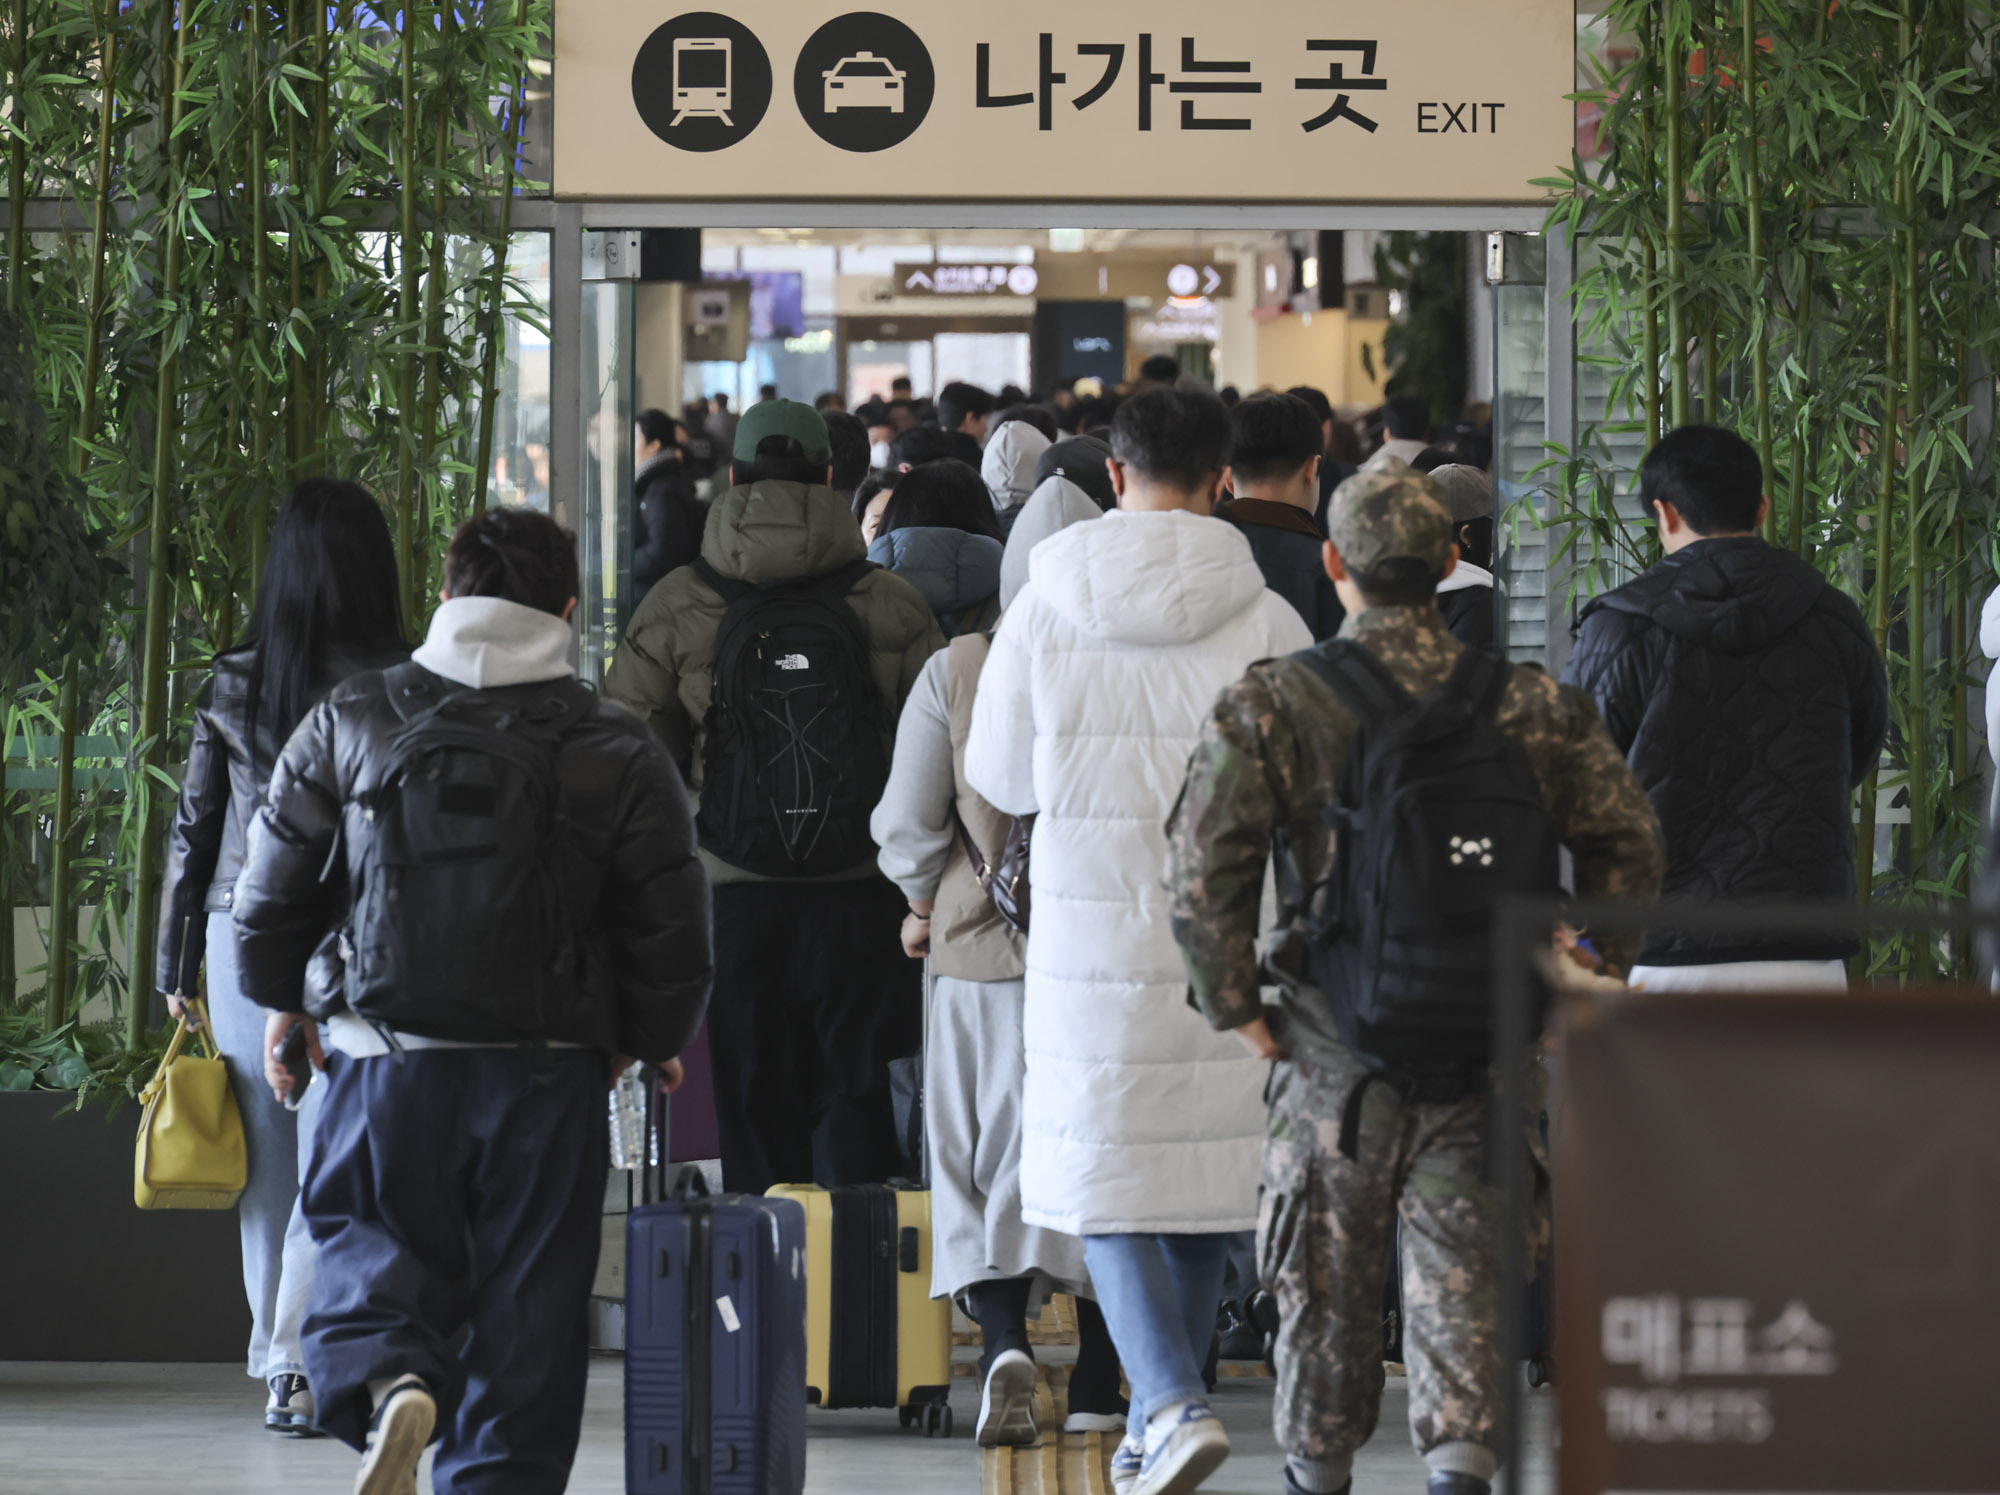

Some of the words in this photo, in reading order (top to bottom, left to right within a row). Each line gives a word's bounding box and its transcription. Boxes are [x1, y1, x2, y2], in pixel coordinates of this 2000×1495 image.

[975, 32, 1262, 132] 나가는
[1294, 39, 1388, 134] 곳
[1417, 102, 1506, 134] EXIT
[1601, 1295, 1835, 1381] 매표소
[1604, 1389, 1770, 1441] TICKETS
